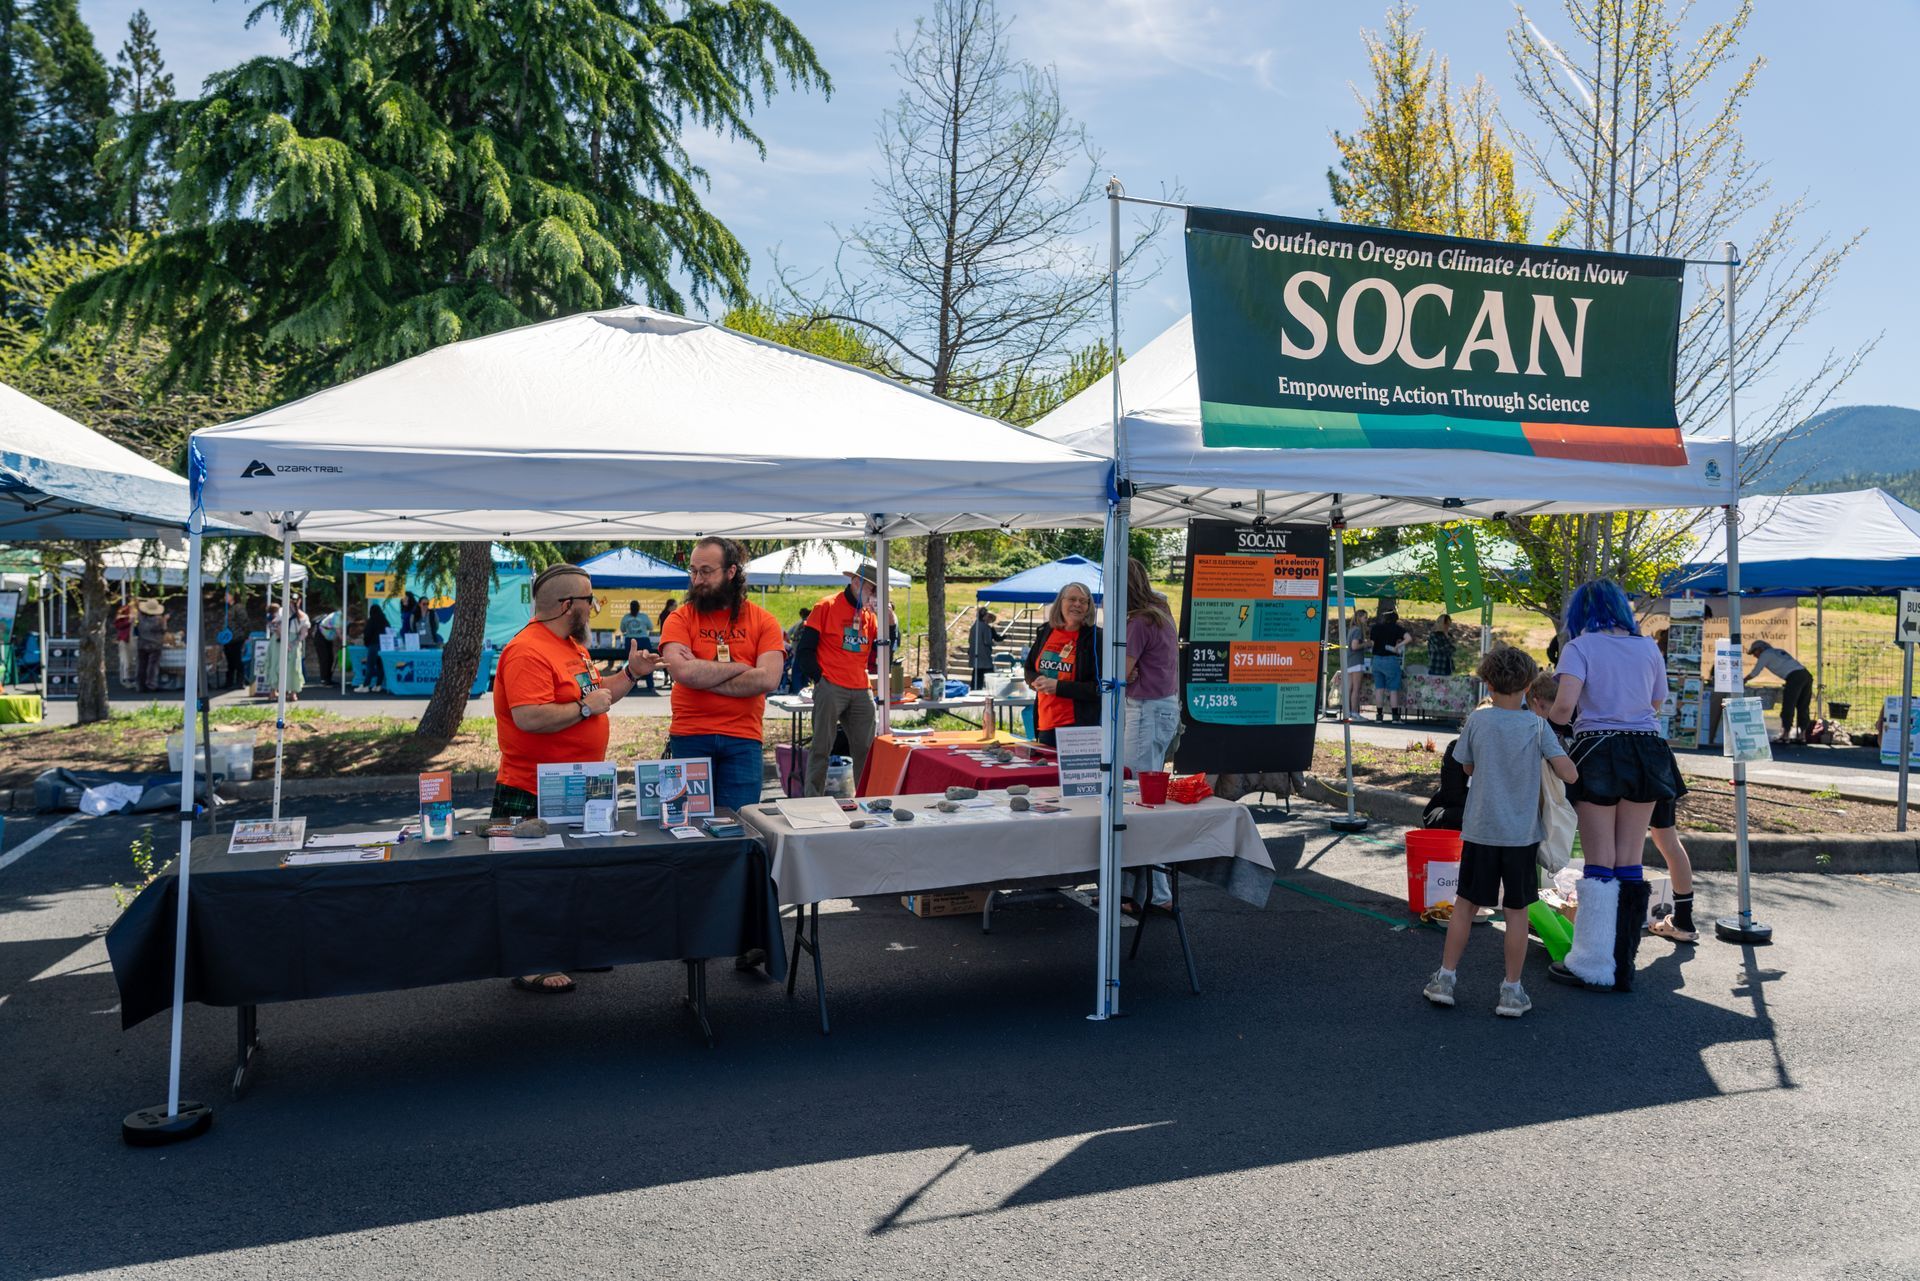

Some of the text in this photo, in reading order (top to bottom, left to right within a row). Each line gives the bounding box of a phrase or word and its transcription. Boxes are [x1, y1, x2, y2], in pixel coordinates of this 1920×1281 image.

[1251, 227, 1629, 286] Southern Oregon Climate Action Now
[1280, 270, 1594, 378] SOCAN
[1278, 375, 1590, 414] Empowering Action Through Science
[276, 465, 312, 473] OZARK
[1238, 533, 1286, 548] SOCAN
[1290, 558, 1320, 567] electrify
[1274, 566, 1319, 580] oregon
[1742, 617, 1789, 626] onnection
[844, 636, 869, 645] SOCAN
[1760, 631, 1789, 640] Water
[1193, 648, 1216, 661] 31%
[1233, 652, 1293, 667] $75 Million
[1039, 660, 1072, 672] SOCAN
[1193, 694, 1238, 709] +7,538%
[1437, 877, 1460, 887] Garb
